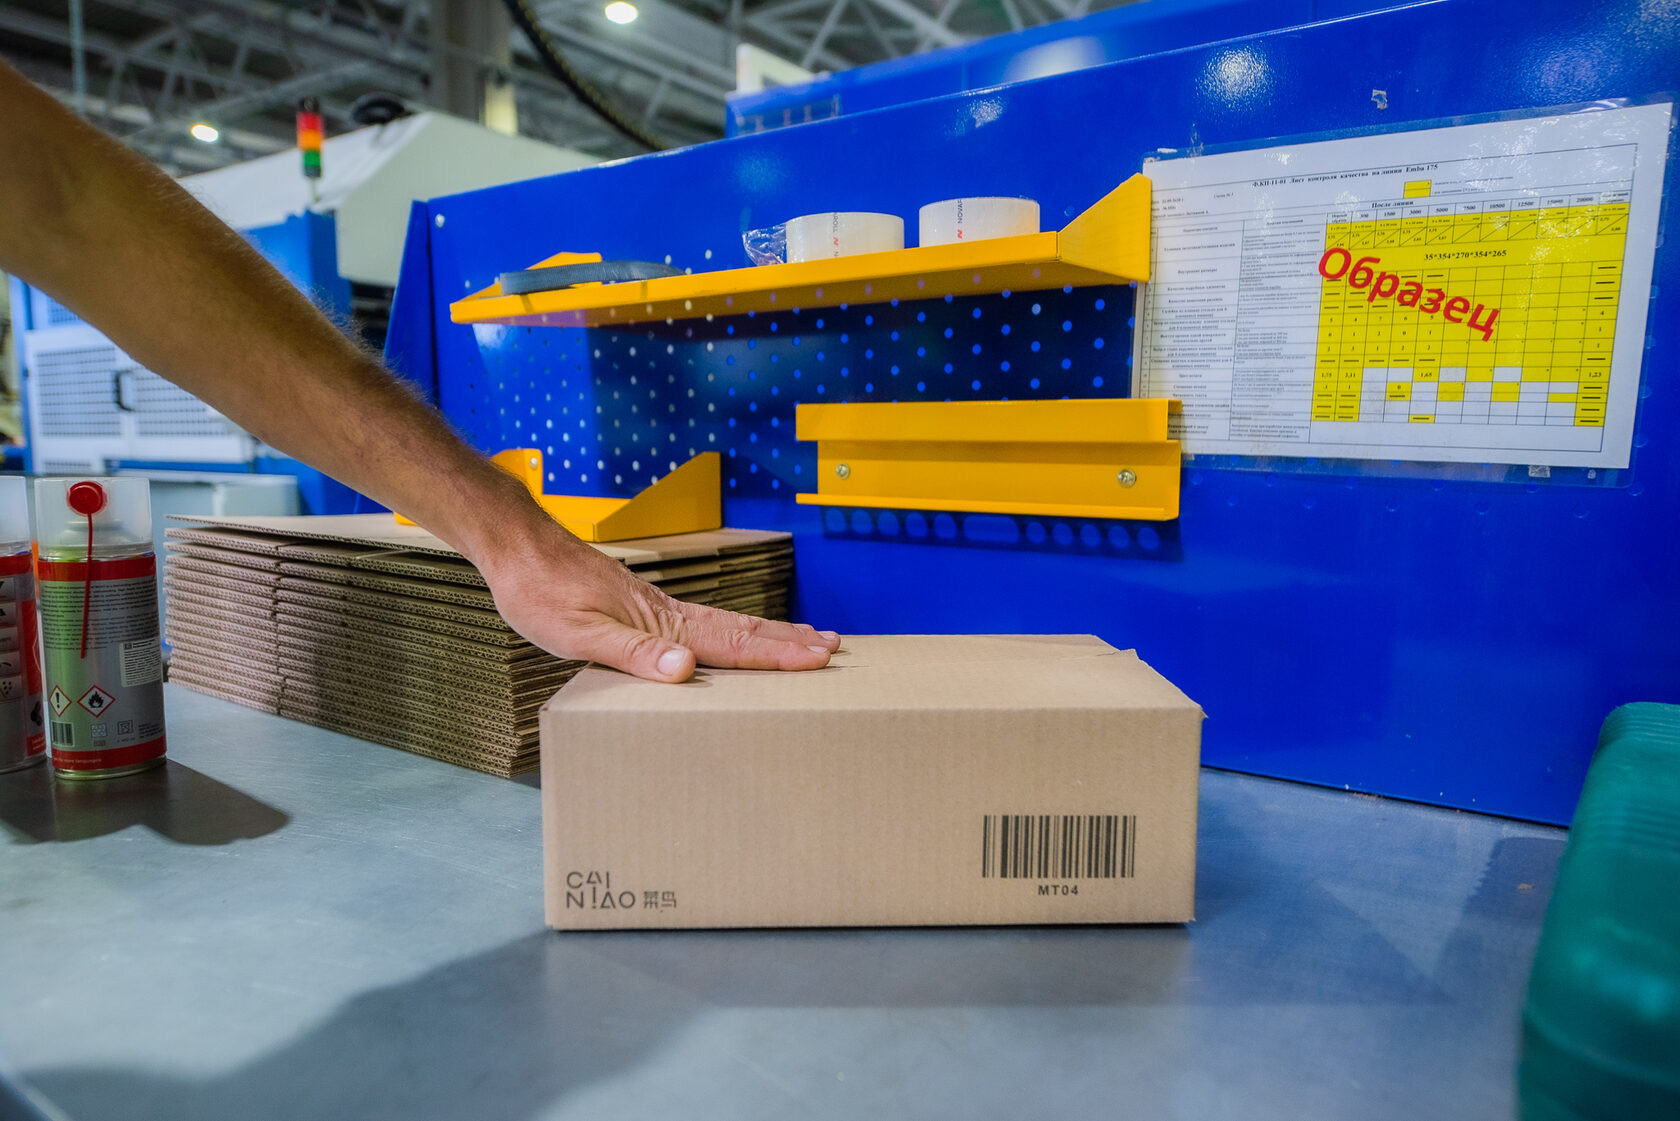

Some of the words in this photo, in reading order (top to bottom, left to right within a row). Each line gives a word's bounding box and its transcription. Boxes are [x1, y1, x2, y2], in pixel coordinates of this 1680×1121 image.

[1318, 248, 1500, 342] Образец
[566, 871, 610, 889] CAI
[1038, 885, 1079, 896] MT04
[644, 891, 677, 908] 菜鸟
